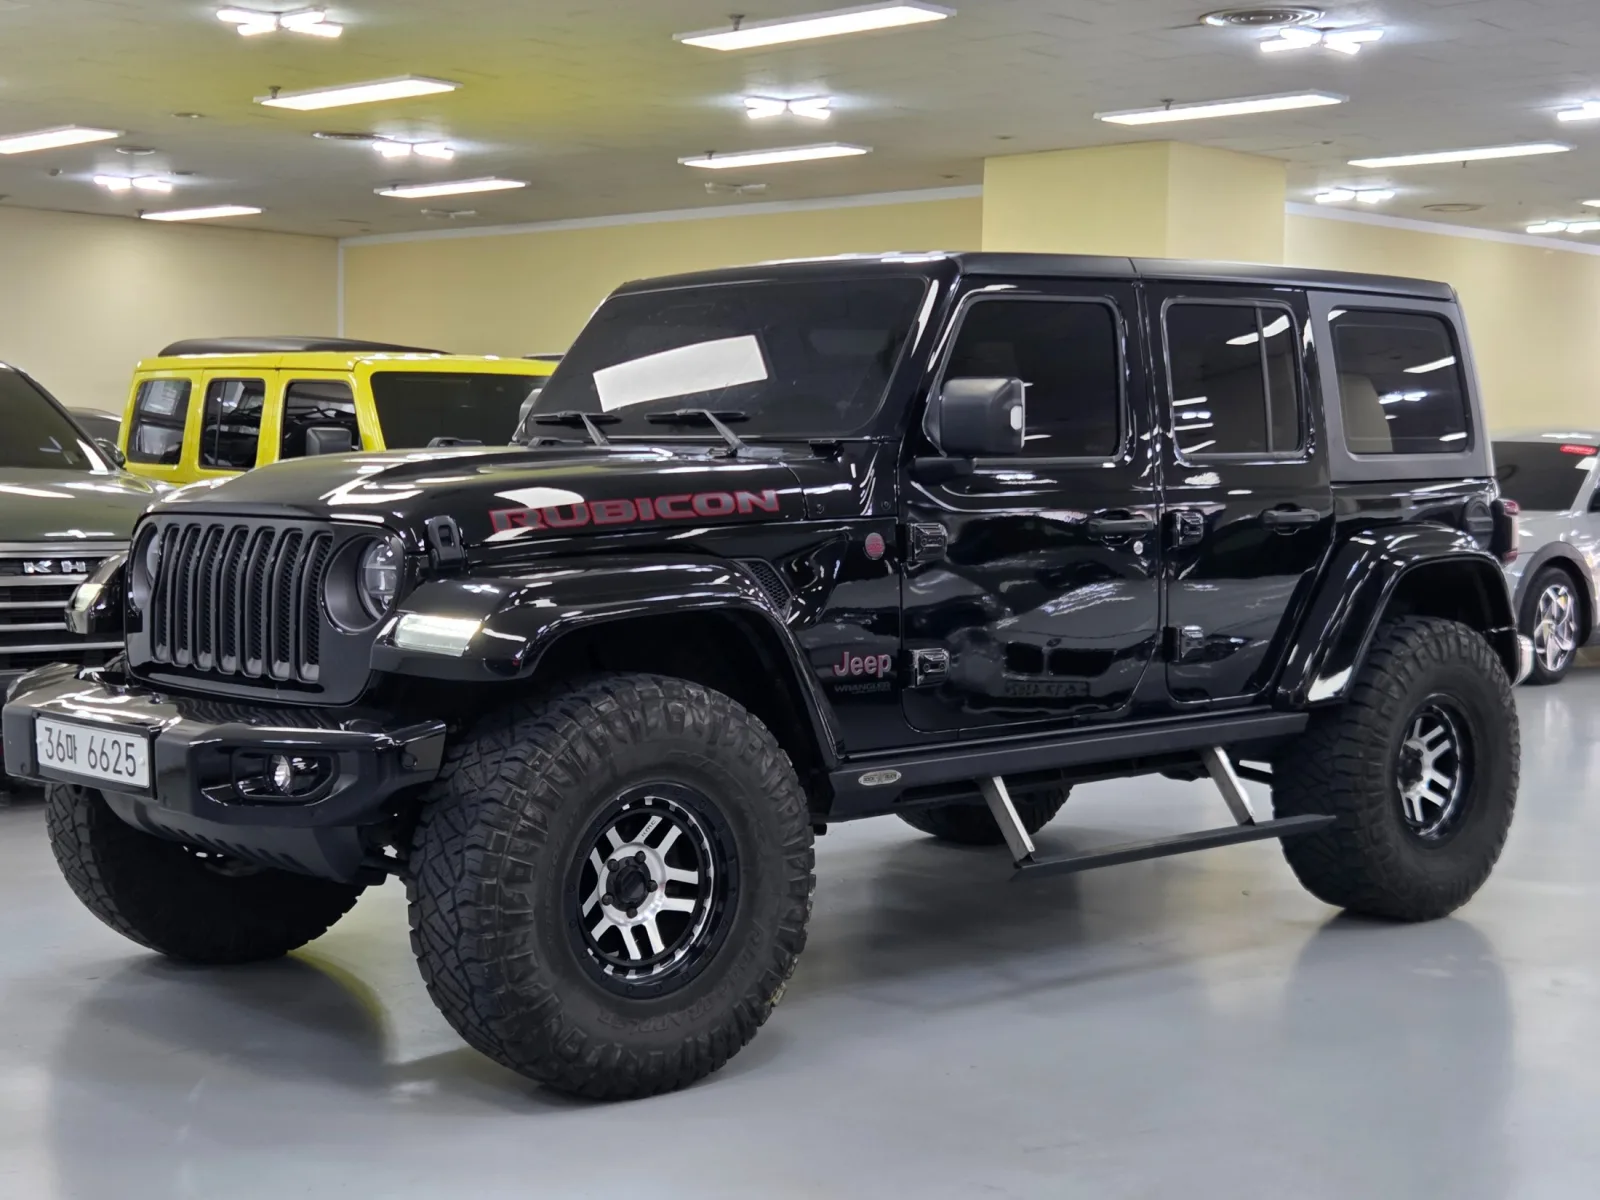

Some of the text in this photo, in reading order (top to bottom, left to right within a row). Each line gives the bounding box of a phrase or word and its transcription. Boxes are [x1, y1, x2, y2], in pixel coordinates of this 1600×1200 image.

[488, 489, 780, 533] RUBICON
[833, 651, 892, 678] Jeep
[44, 726, 137, 778] 36마 6625
